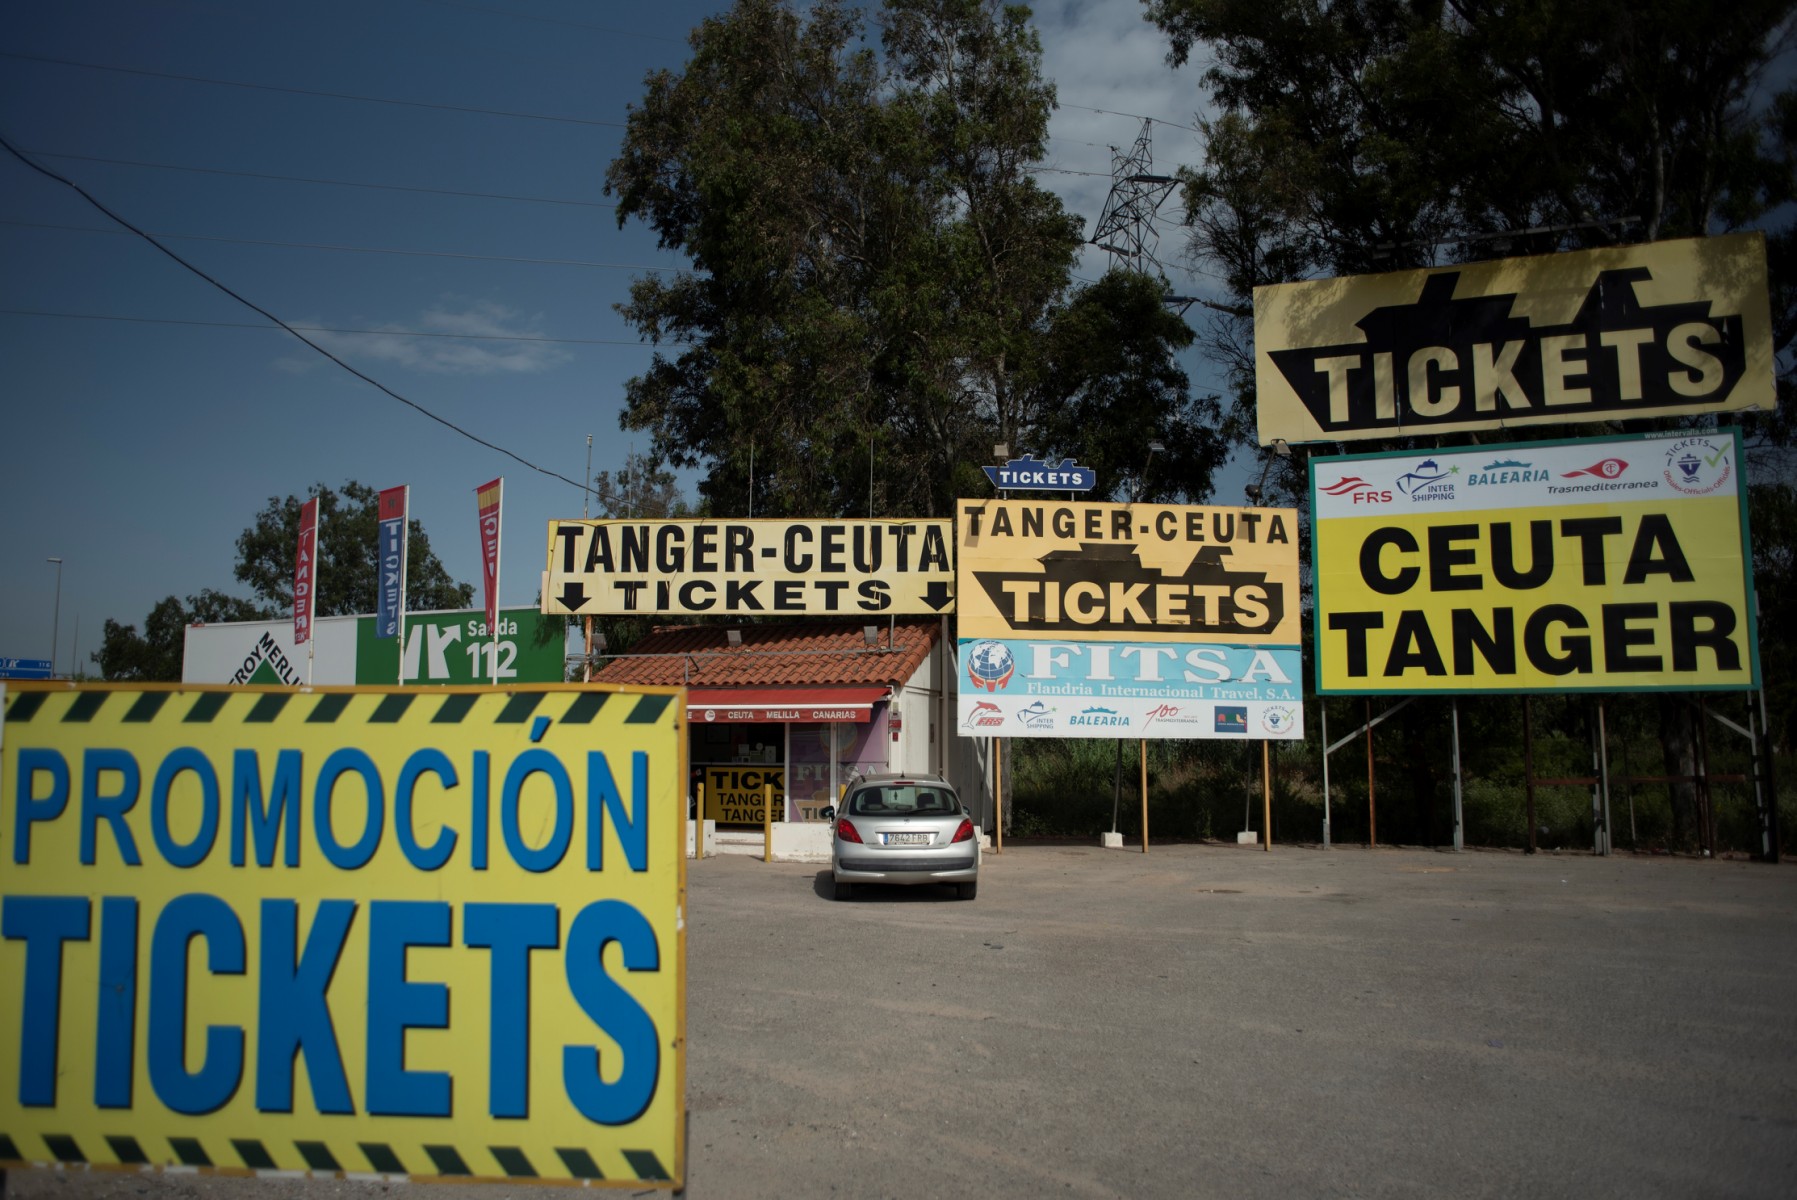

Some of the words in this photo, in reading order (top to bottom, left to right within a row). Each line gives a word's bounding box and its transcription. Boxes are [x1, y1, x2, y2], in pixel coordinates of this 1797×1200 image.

[1313, 322, 1725, 424] TICKETS
[1665, 438, 1711, 457] TICKETS
[1000, 471, 1083, 485] TICKETS
[1428, 484, 1454, 494] INTER
[1468, 469, 1549, 486] BALEARIA
[1547, 480, 1659, 494] Trasmediterranea
[1353, 490, 1393, 504] FRS
[1412, 492, 1455, 502] SHIPPING
[964, 506, 1288, 544] TANGER-CEUTA
[557, 524, 950, 573] TANGER-CEUTA
[1359, 514, 1695, 595] CEUTA
[613, 580, 892, 611] TICKETS
[1002, 580, 1270, 628] TICKETS
[468, 618, 517, 637] Sada
[1328, 601, 1743, 677] TANGER
[229, 645, 262, 684] ROY
[259, 631, 304, 685] MERLI
[466, 640, 517, 678] 112
[1027, 644, 1292, 684] FITSA
[1027, 682, 1094, 696] Flandria
[1101, 683, 1203, 698] Internacional
[1211, 686, 1262, 701] Travel,
[1266, 688, 1295, 700] S.A.
[728, 711, 754, 719] CEUTA
[766, 711, 800, 719] MELILLA
[812, 711, 856, 719] CANARIAS
[1069, 715, 1130, 726] BALEARIA
[14, 717, 650, 873] PROMOCIÓN
[2, 892, 661, 1126] TICKETS
